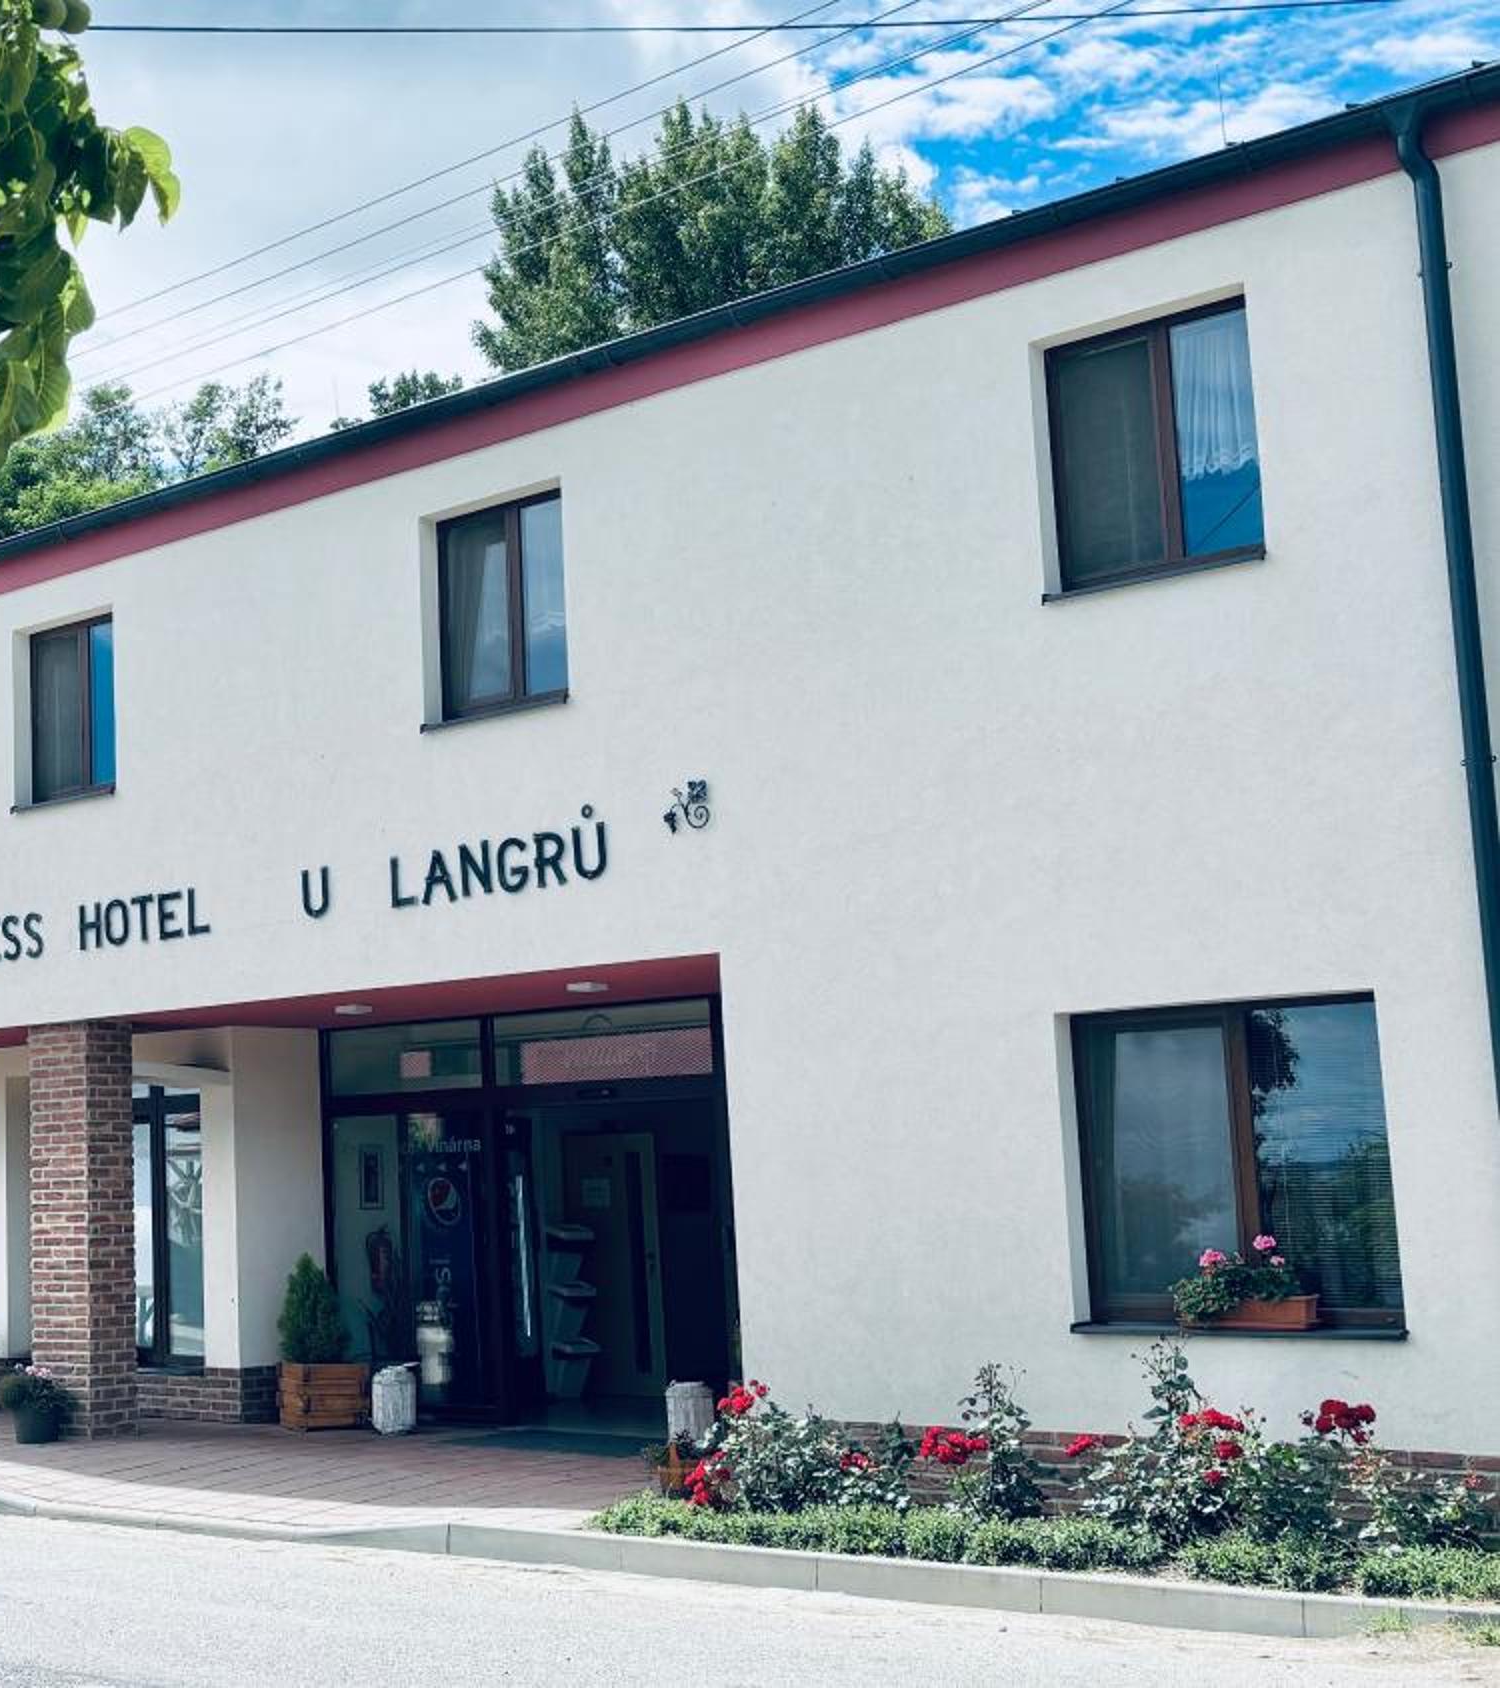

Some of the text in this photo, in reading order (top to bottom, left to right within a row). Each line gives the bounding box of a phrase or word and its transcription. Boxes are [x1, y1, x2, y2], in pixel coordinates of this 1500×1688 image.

[78, 887, 211, 952] HOTEL
[301, 865, 330, 920] U
[389, 803, 608, 909] LANGRŮ
